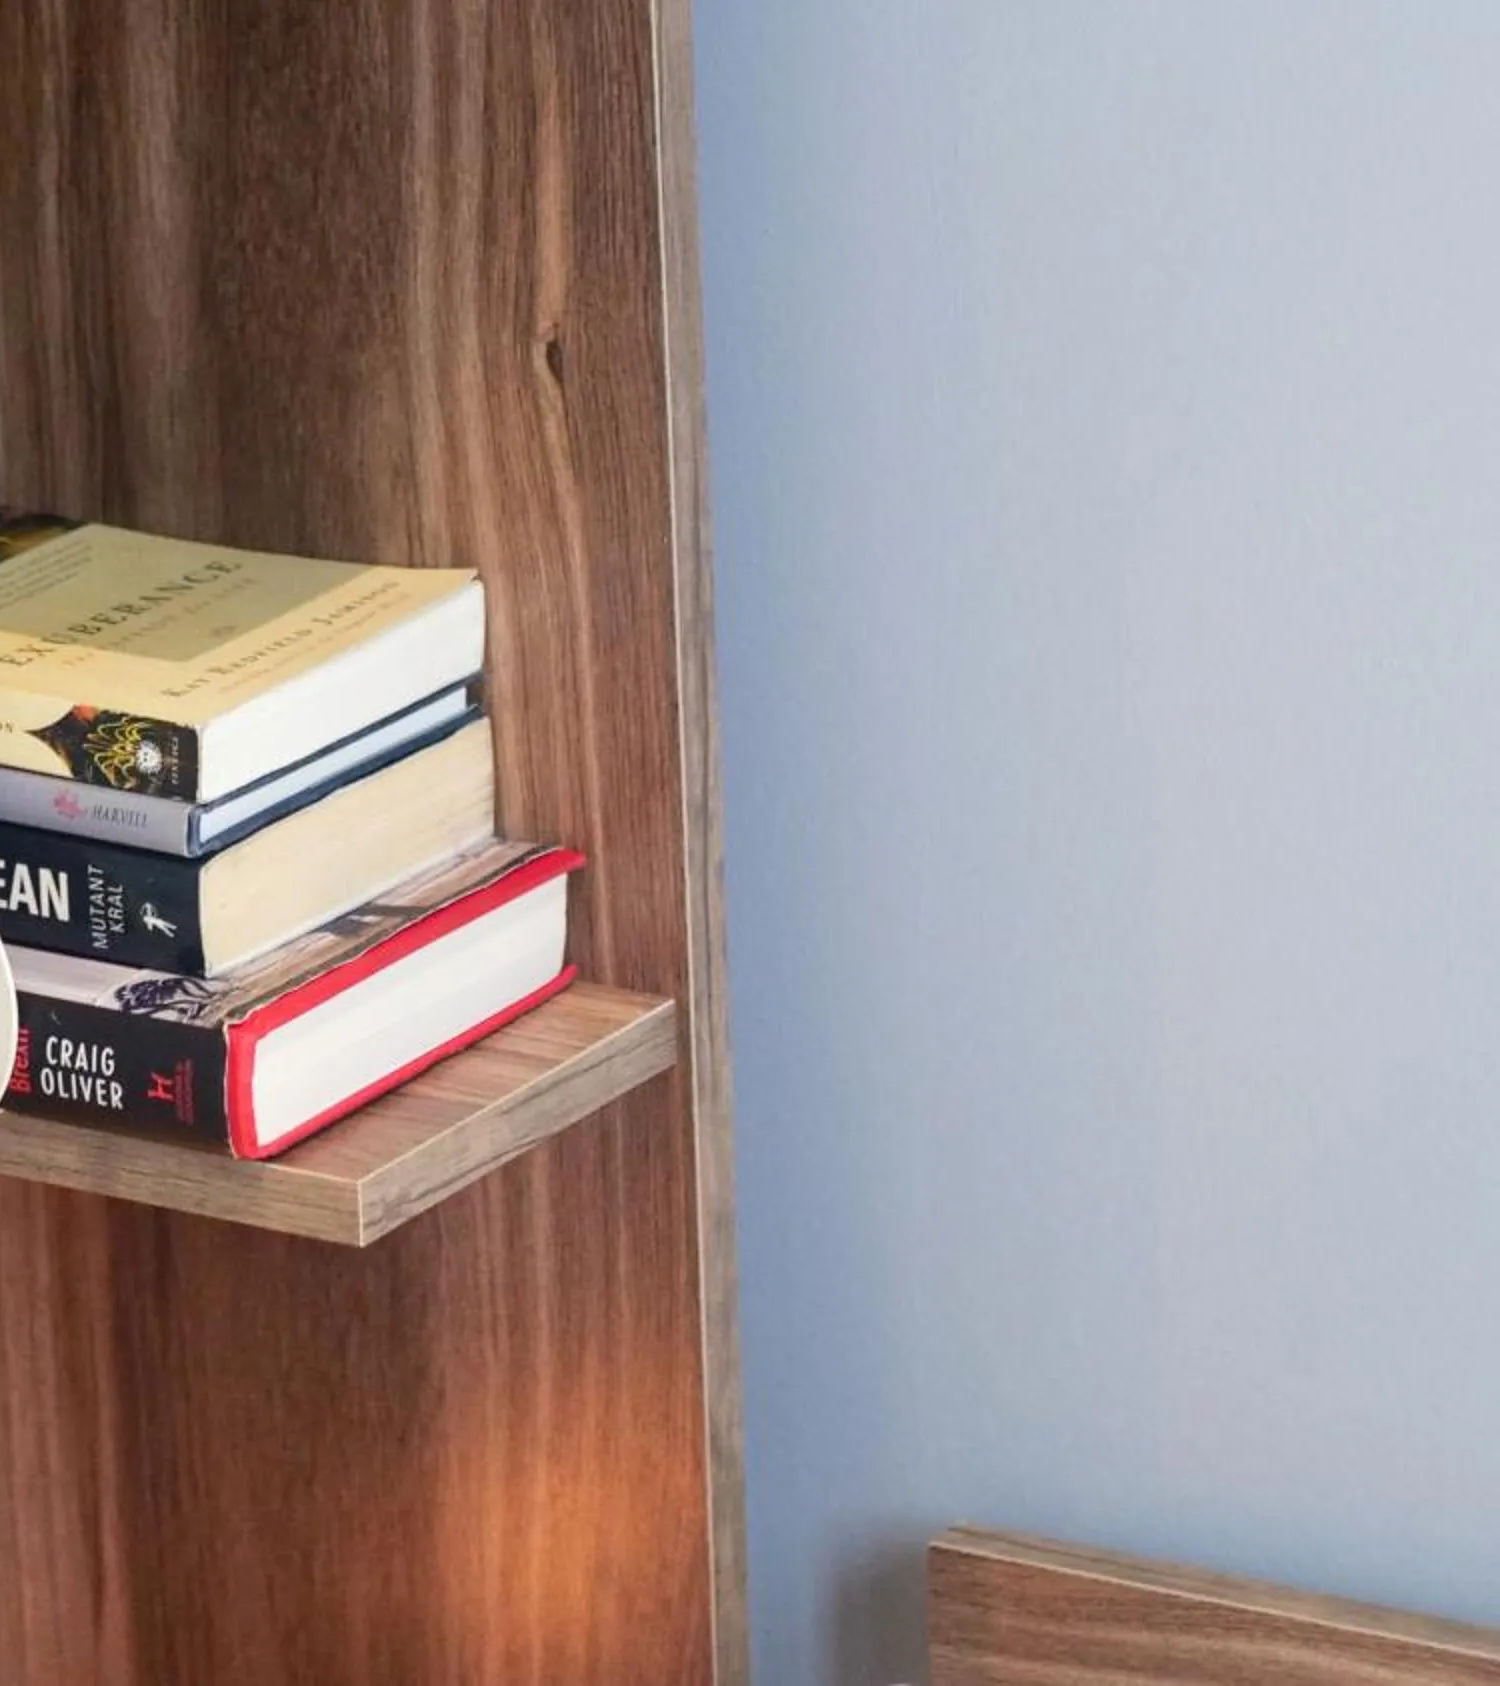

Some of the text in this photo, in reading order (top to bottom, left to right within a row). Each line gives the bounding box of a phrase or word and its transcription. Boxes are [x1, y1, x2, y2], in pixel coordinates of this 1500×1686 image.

[87, 863, 109, 950] MUTANT
[107, 883, 126, 934] KRAL
[45, 1035, 116, 1077] CRAIG
[39, 1067, 124, 1110] OLIVER
